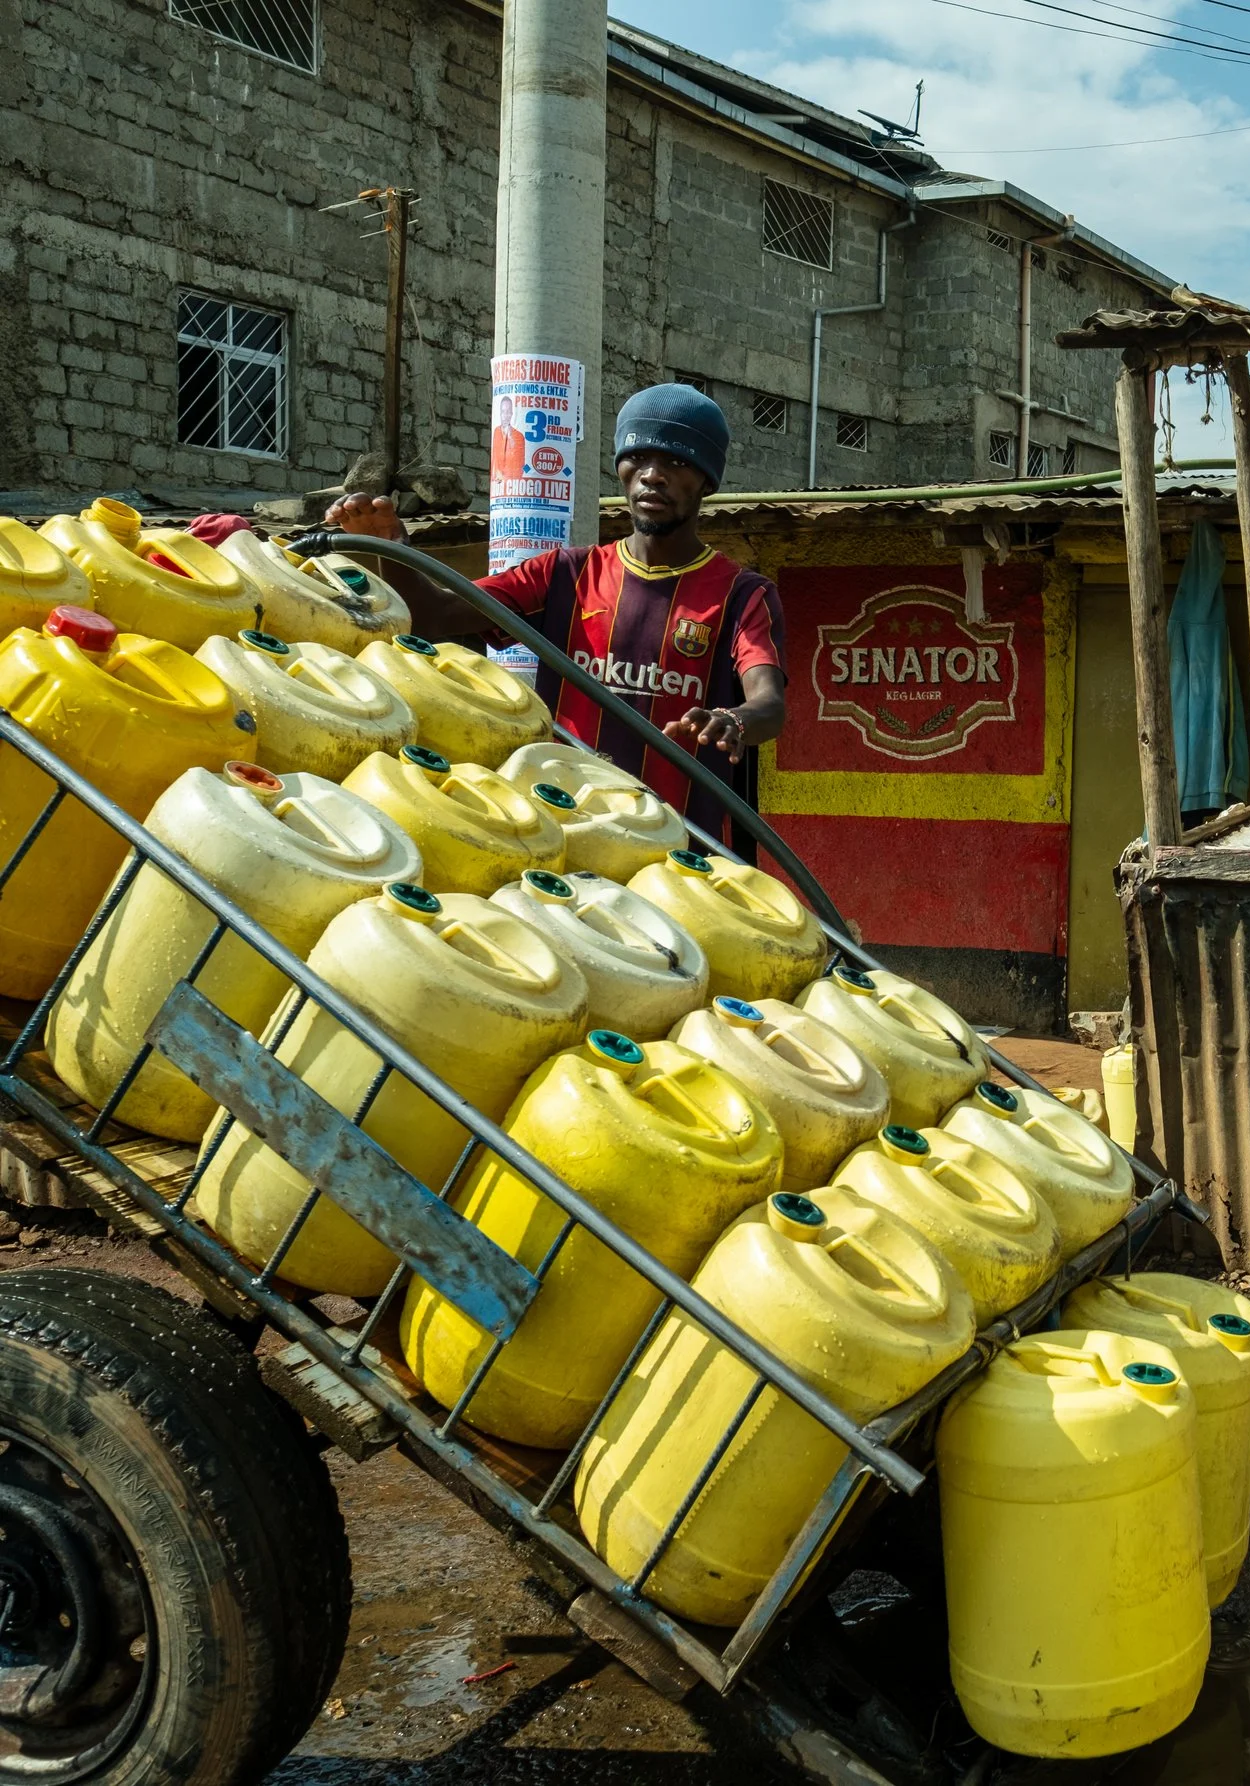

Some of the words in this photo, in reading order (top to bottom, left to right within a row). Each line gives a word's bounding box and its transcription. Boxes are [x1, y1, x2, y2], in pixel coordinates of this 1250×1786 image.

[500, 359, 527, 382] VEGAS
[529, 359, 571, 385] LOUNGE
[514, 384, 539, 395] SOUNDS
[540, 386, 545, 394] &
[515, 395, 568, 411] PRESENTS
[525, 410, 547, 442] 3
[547, 415, 561, 426] RD
[547, 425, 573, 436] FRIDAY
[538, 452, 559, 461] ENTRY
[506, 479, 542, 497] CHOGO
[544, 481, 569, 500] LIVE
[495, 517, 521, 537] VEGAS
[523, 517, 566, 539] LOUNGE
[507, 538, 533, 548] SOUNDS
[534, 541, 539, 549] &
[573, 650, 703, 701] Rakuten
[831, 646, 1001, 684] SENATOR
[886, 690, 908, 701] KEG
[909, 690, 942, 700] LAGER
[93, 1436, 187, 1570] WINTER
[173, 1572, 206, 1687] MAXX
